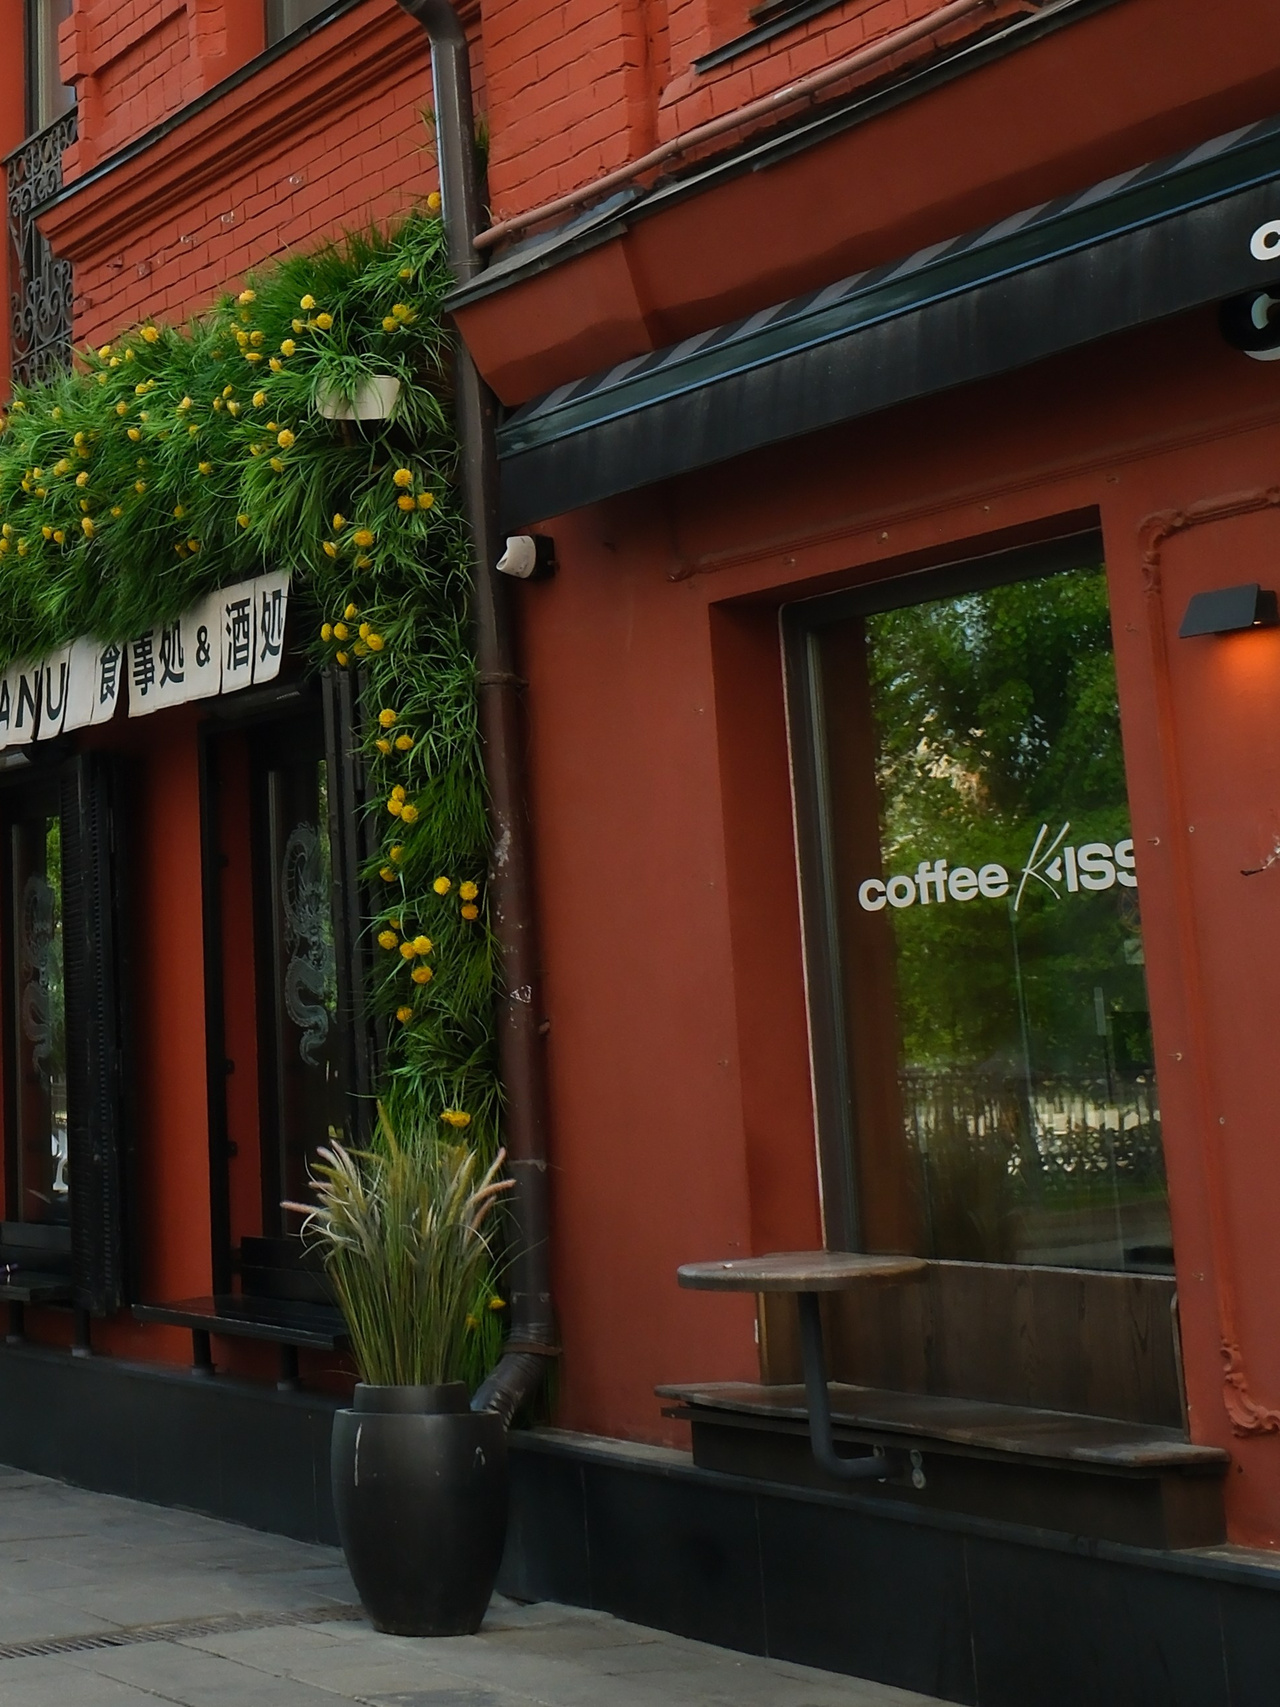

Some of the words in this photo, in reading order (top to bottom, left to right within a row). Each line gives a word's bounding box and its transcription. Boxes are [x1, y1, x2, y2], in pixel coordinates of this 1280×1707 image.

[99, 619, 184, 704] 食事処
[195, 624, 211, 668] &
[225, 588, 284, 671] 酒処
[858, 858, 1009, 912] coffee
